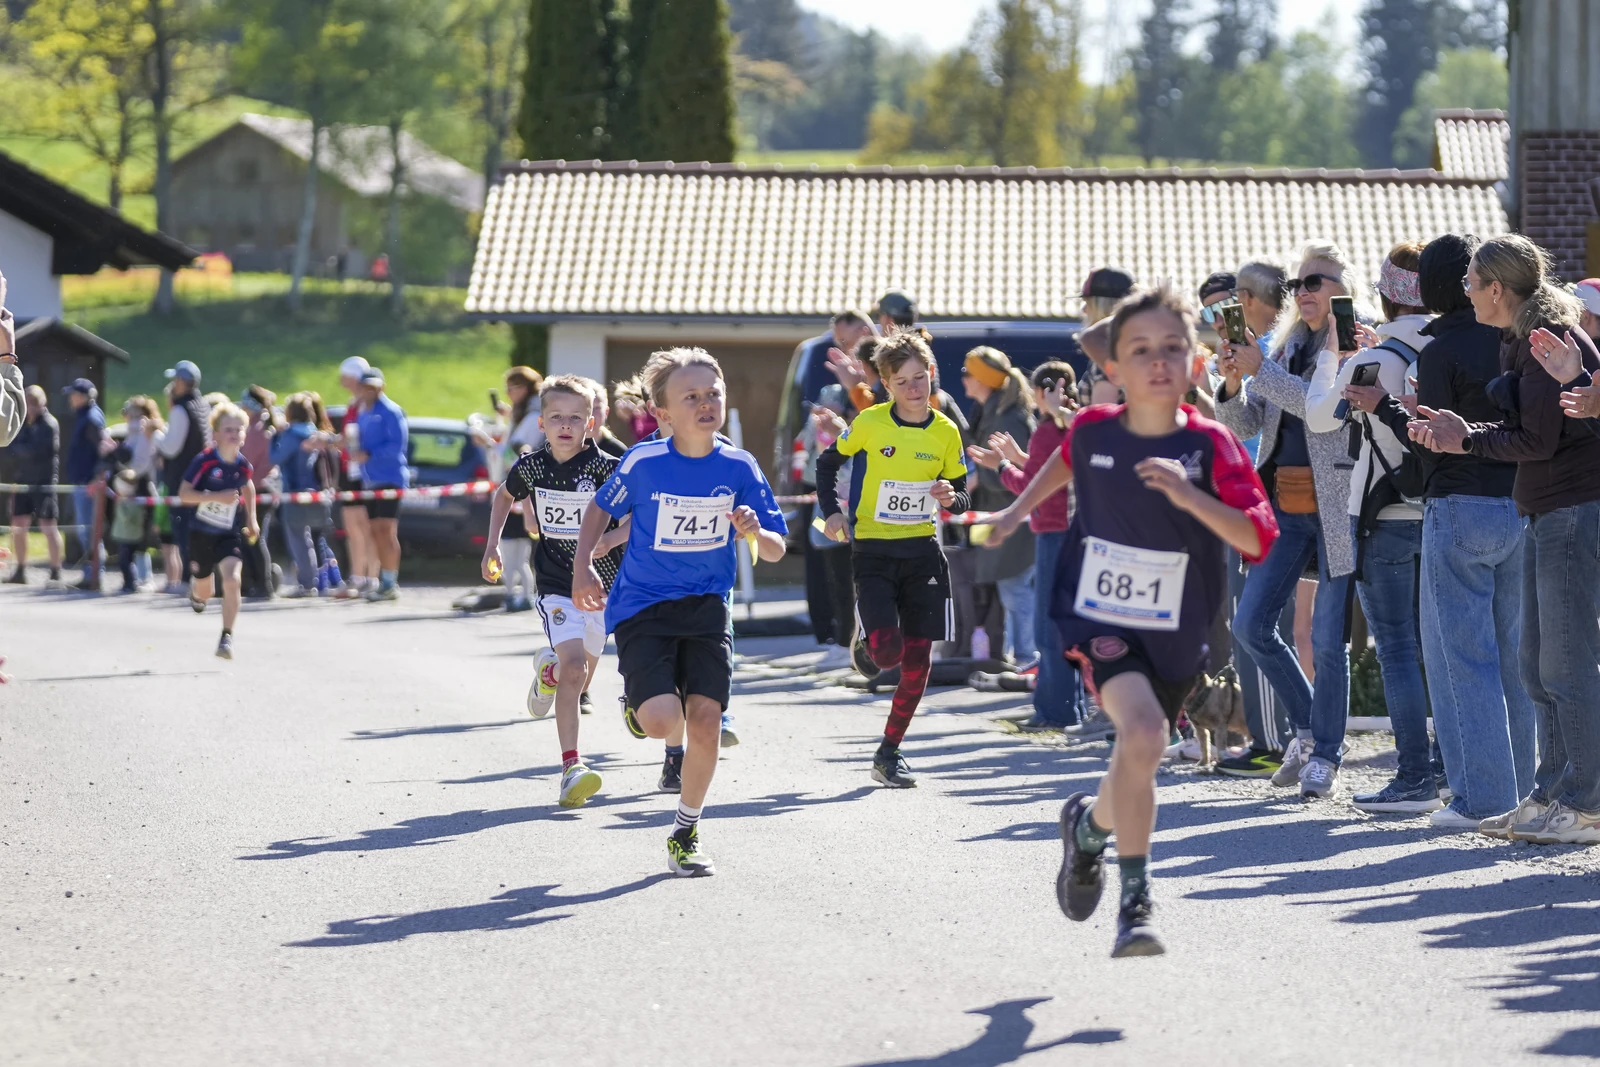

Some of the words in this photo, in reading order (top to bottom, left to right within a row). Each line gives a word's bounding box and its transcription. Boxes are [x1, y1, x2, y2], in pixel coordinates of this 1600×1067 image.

[888, 495, 925, 511] 86-1
[545, 506, 581, 525] 52-1
[673, 515, 718, 535] 74-1
[1097, 569, 1162, 604] 68-1
